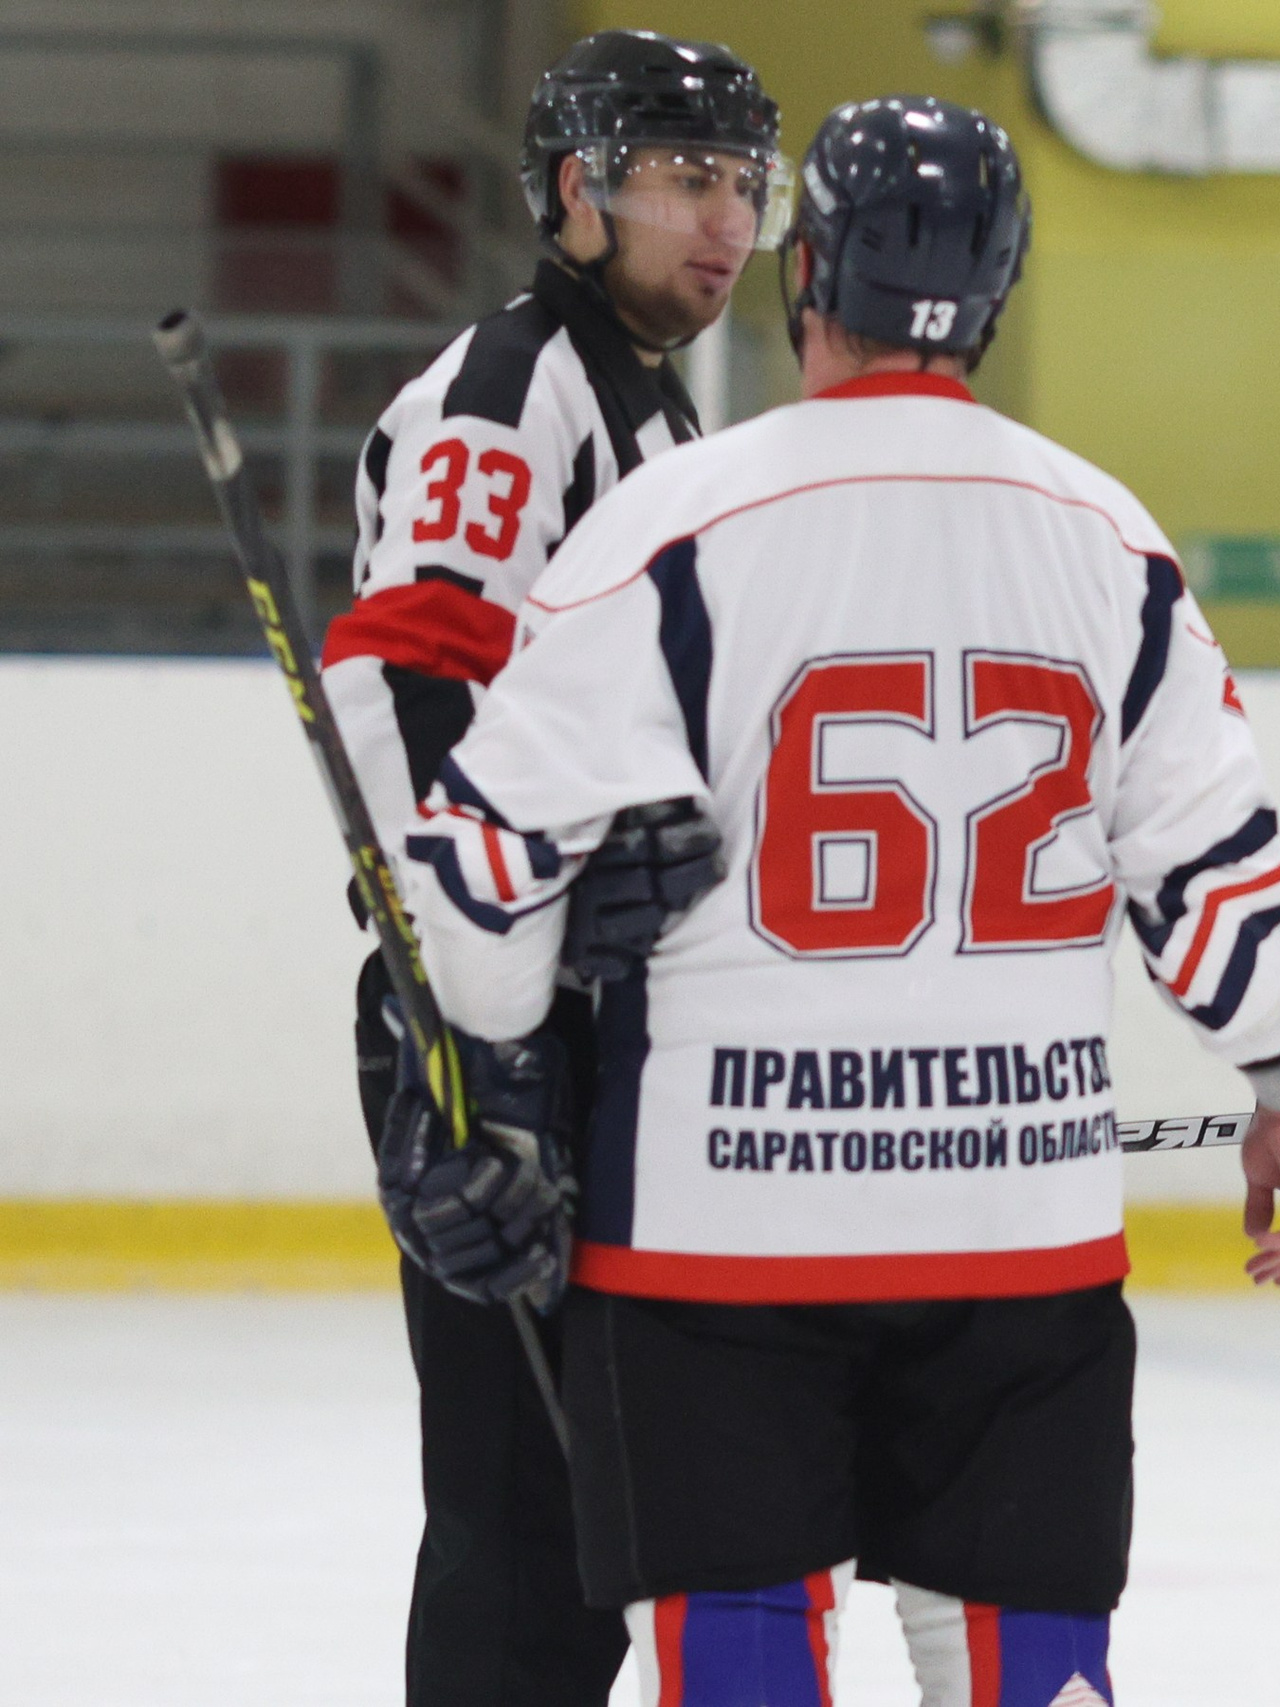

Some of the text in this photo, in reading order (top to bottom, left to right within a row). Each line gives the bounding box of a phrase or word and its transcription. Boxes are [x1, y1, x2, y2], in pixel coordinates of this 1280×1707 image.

[910, 299, 958, 340] 13
[412, 437, 532, 562] 33
[749, 649, 1117, 961] 62
[709, 1036, 1111, 1108] ПРАВИТЕЛЬСТВ
[707, 1120, 1008, 1172] САРАТОВСКОЙ
